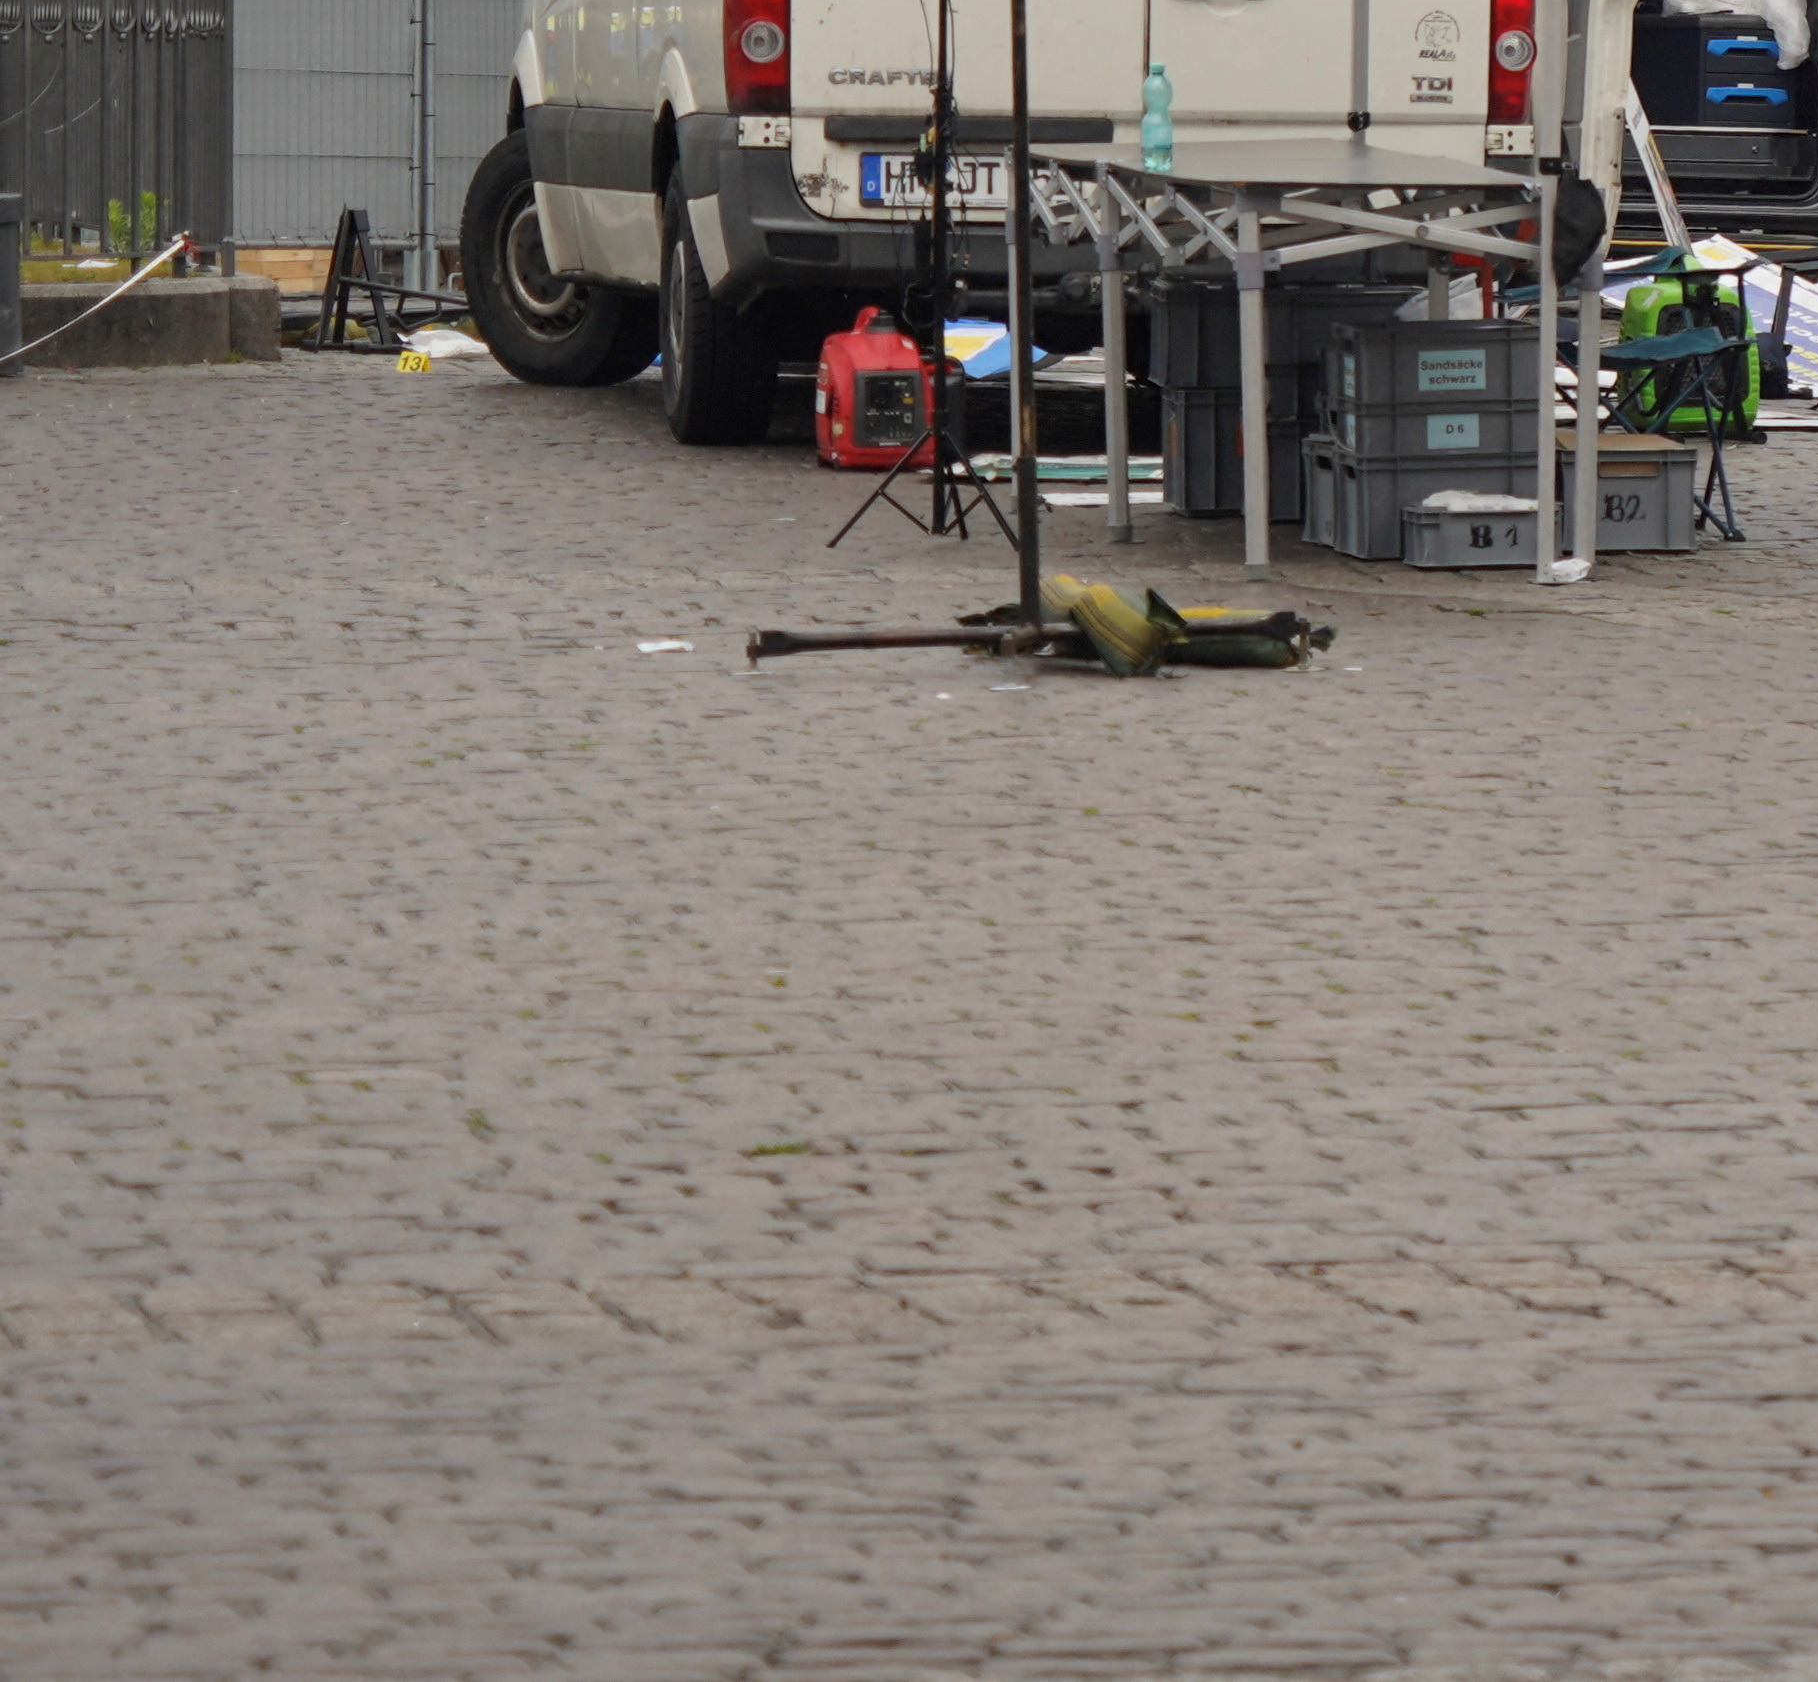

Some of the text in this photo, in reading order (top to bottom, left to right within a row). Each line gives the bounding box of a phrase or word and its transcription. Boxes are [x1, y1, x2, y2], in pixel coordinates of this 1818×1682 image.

[828, 67, 936, 86] CRAFTE
[1411, 75, 1452, 91] TDI
[401, 355, 422, 371] 13
[1421, 360, 1483, 371] Sandsäcke
[1429, 374, 1476, 385] schwarz
